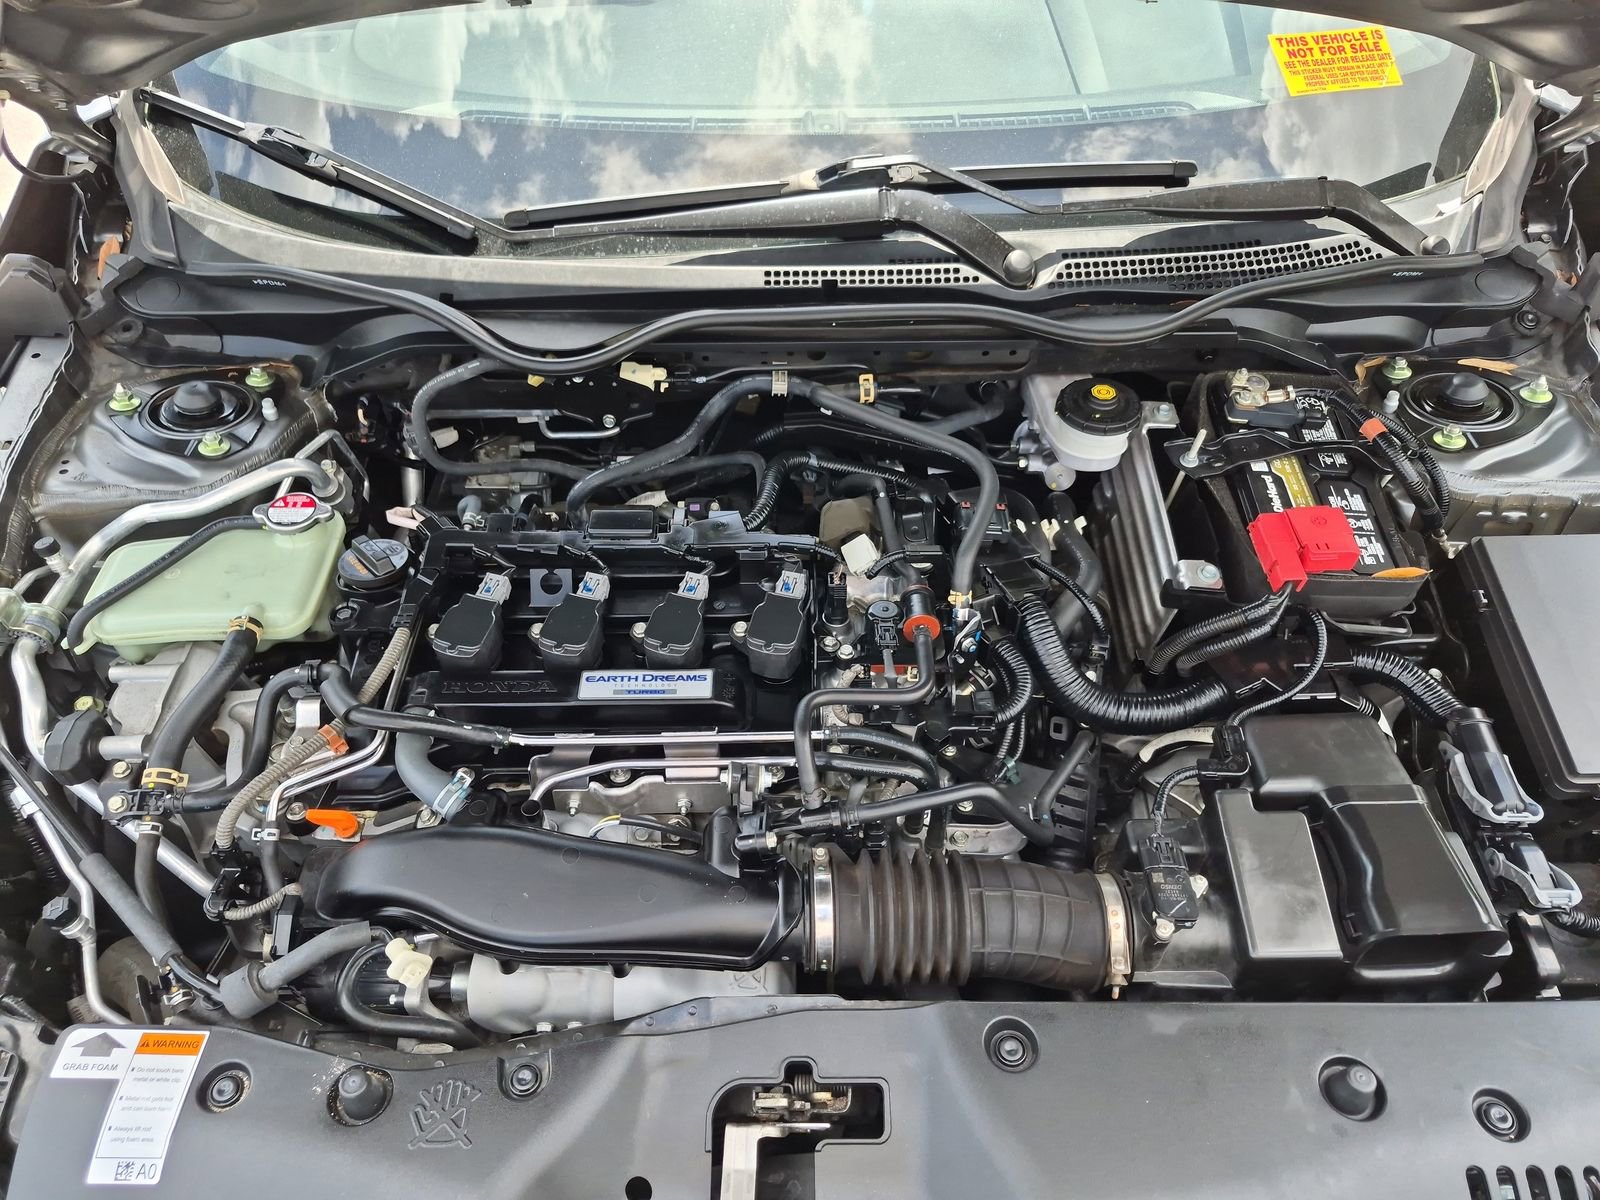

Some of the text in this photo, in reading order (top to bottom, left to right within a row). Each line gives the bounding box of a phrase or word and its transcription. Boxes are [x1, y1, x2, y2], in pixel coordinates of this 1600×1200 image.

[1276, 30, 1383, 48] THIS VEHICLE IS
[1286, 42, 1382, 59] NOT FOR SALE
[1284, 61, 1297, 69] SEE
[1312, 58, 1336, 66] DEALER
[1351, 54, 1377, 63] RELEASE
[1377, 52, 1392, 60] DATE
[442, 680, 557, 693] HONDA
[642, 674, 708, 682] DREAMS
[152, 1040, 200, 1049] WARNING
[135, 1163, 157, 1180] A0
